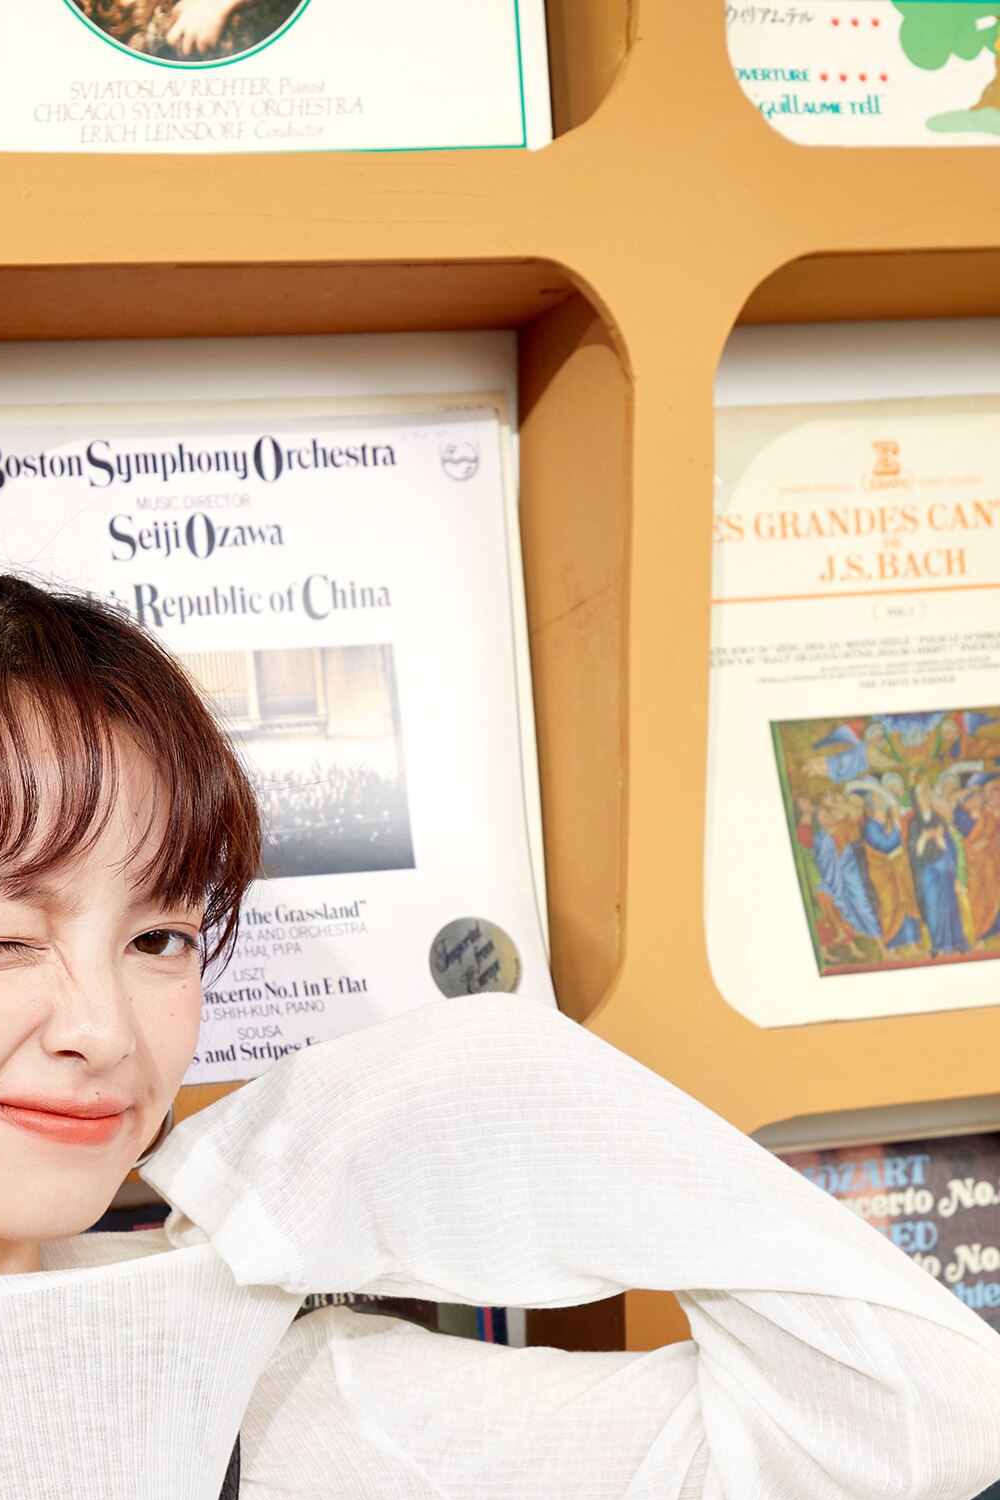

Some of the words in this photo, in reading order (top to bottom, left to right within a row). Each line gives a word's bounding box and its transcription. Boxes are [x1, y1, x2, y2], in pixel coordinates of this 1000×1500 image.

[69, 80, 187, 100] SVIATOSLAV
[190, 76, 274, 98] RICHTER
[33, 102, 126, 123] CHICAGO
[131, 99, 246, 121] SYMPHONY
[250, 97, 365, 118] ORCHESTRA
[79, 122, 137, 143] ERICH
[85, 439, 249, 488] Symphony
[253, 434, 398, 483] Orchestra
[136, 495, 179, 511] MUSIC
[183, 492, 252, 510] DIRECTOR
[711, 512, 745, 544] ES
[753, 503, 921, 541] GRANDES
[926, 498, 1000, 532] CAN
[108, 513, 181, 562] Seiji
[184, 511, 285, 560] Ozawa
[132, 582, 264, 627] Republic
[268, 580, 299, 614] of
[301, 572, 393, 621] China
[245, 907, 273, 926] the
[256, 926, 286, 942] AND
[288, 921, 369, 941] ORCHESTRA
[232, 967, 266, 983] LISZT
[201, 986, 263, 1005] oncerto
[303, 979, 321, 996] in
[338, 974, 369, 994] flat
[285, 998, 327, 1016] PIANO
[236, 1024, 284, 1041] SOUSA
[204, 1044, 237, 1065] and
